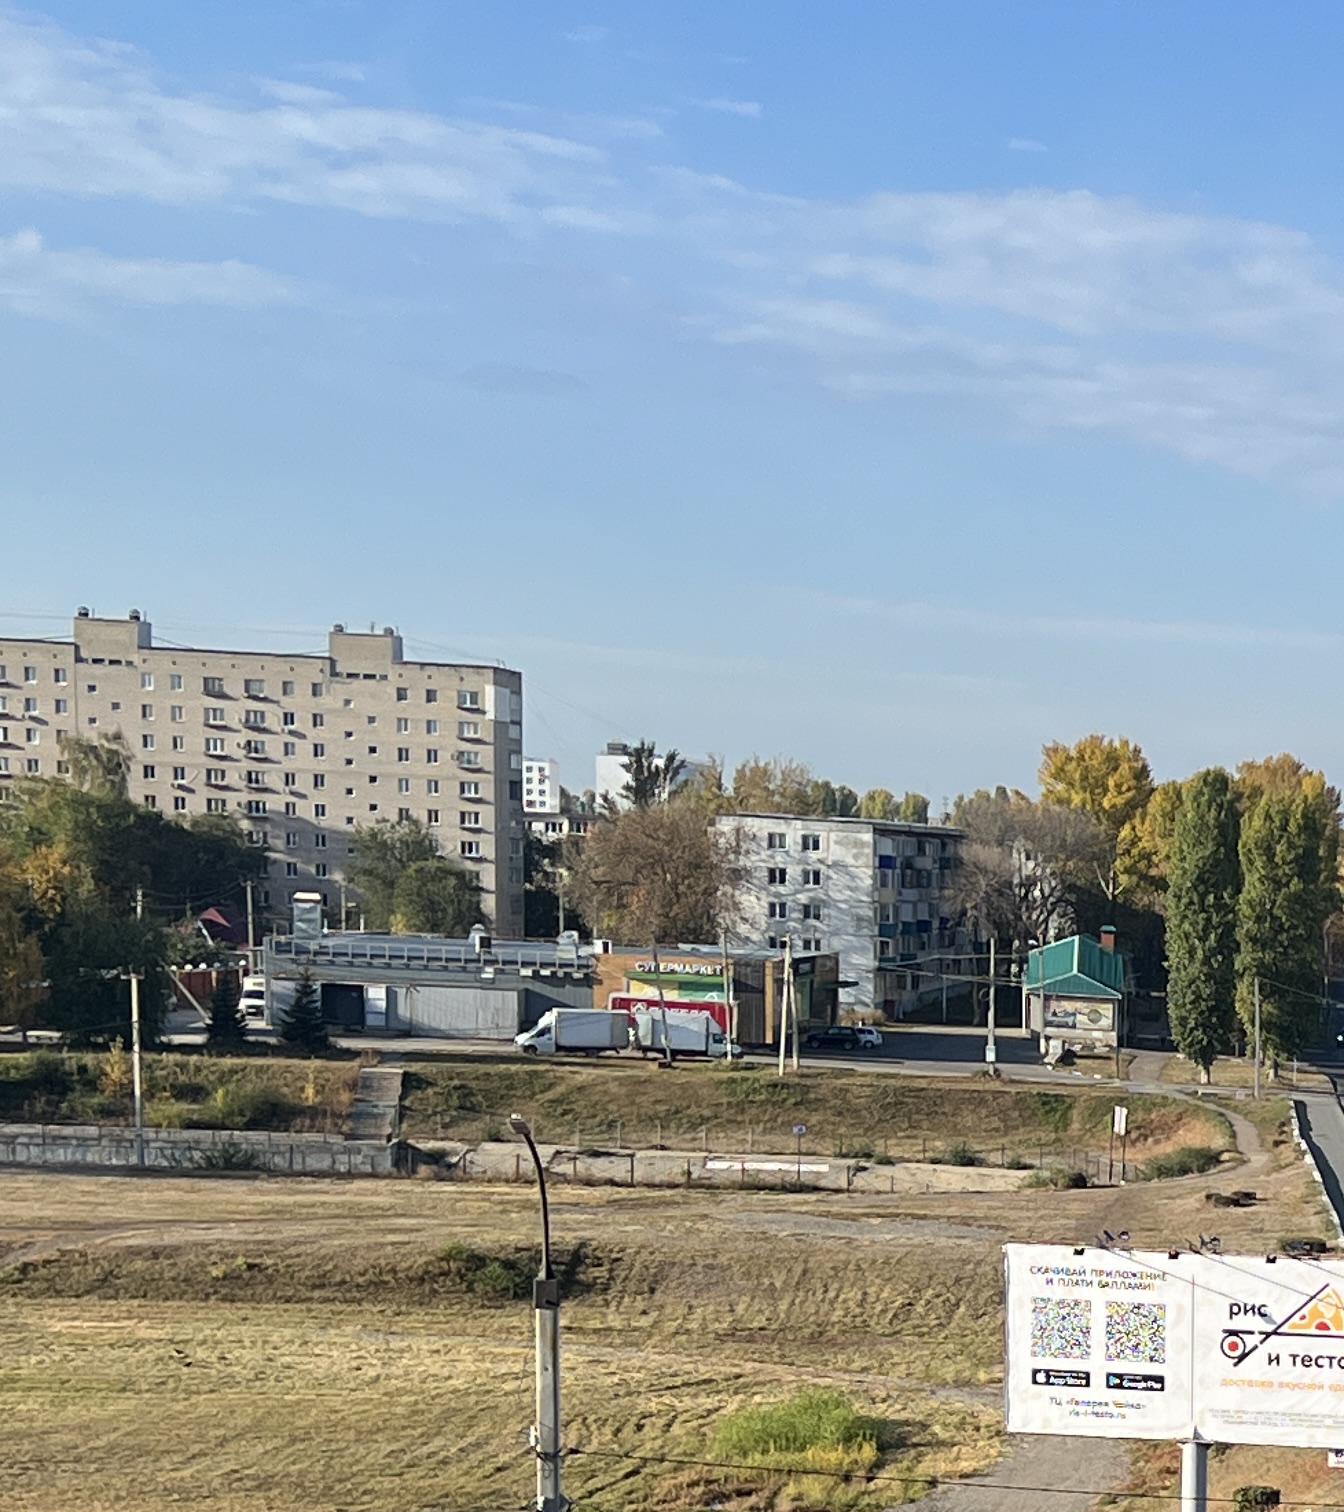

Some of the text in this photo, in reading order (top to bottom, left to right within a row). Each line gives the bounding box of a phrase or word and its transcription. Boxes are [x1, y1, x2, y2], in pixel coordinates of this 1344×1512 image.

[635, 961, 722, 975] СУПЕРМАРКЕТ
[1029, 1265, 1167, 1282] СКАЧИВАЙ ПРИЛОЖЕНИЕ
[1045, 1277, 1054, 1286] И
[1057, 1277, 1093, 1289] ПЛАТИ
[1229, 1302, 1269, 1320] рис
[1267, 1352, 1281, 1367] и
